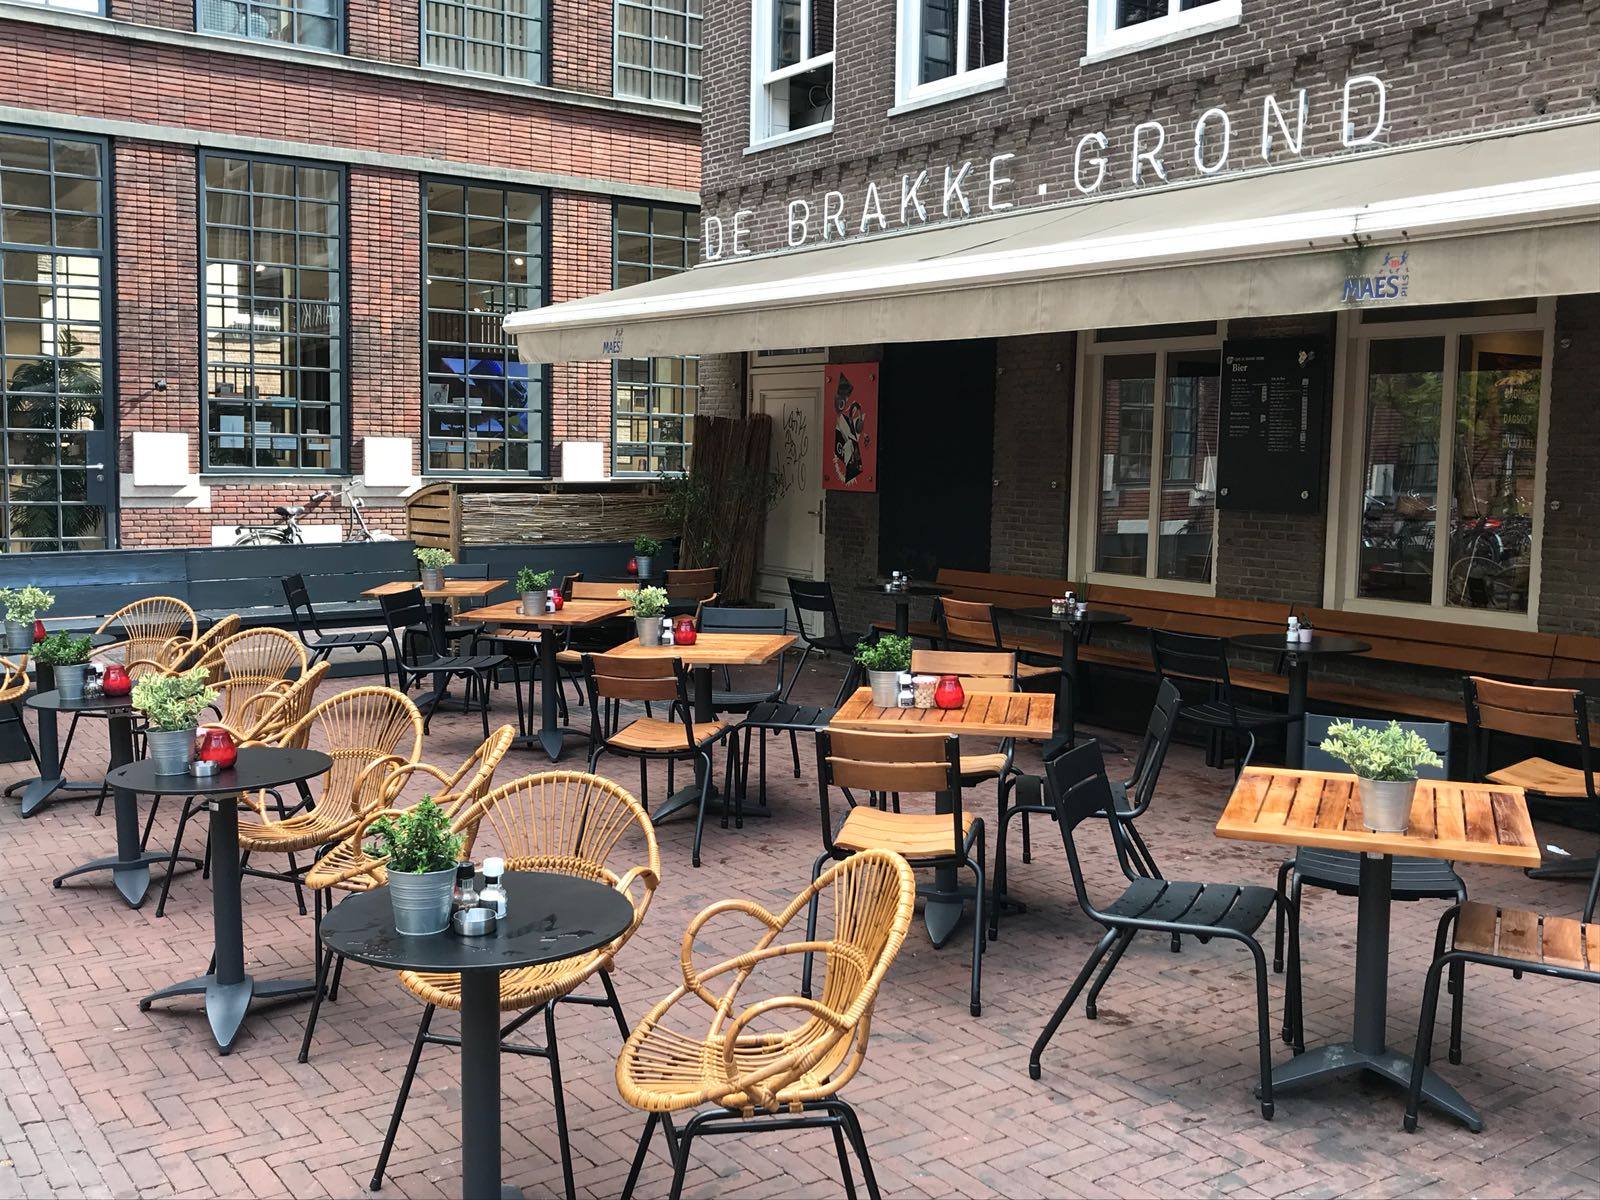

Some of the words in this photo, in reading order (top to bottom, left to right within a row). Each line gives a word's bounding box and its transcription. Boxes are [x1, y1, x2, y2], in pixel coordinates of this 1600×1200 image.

[704, 210, 753, 260] DE
[787, 153, 1017, 247] BRAKKE
[1074, 75, 1387, 194] GROND
[1342, 275, 1399, 300] MAES
[1401, 274, 1409, 297] PILS
[602, 341, 620, 354] MAES
[1232, 363, 1248, 372] Bier
